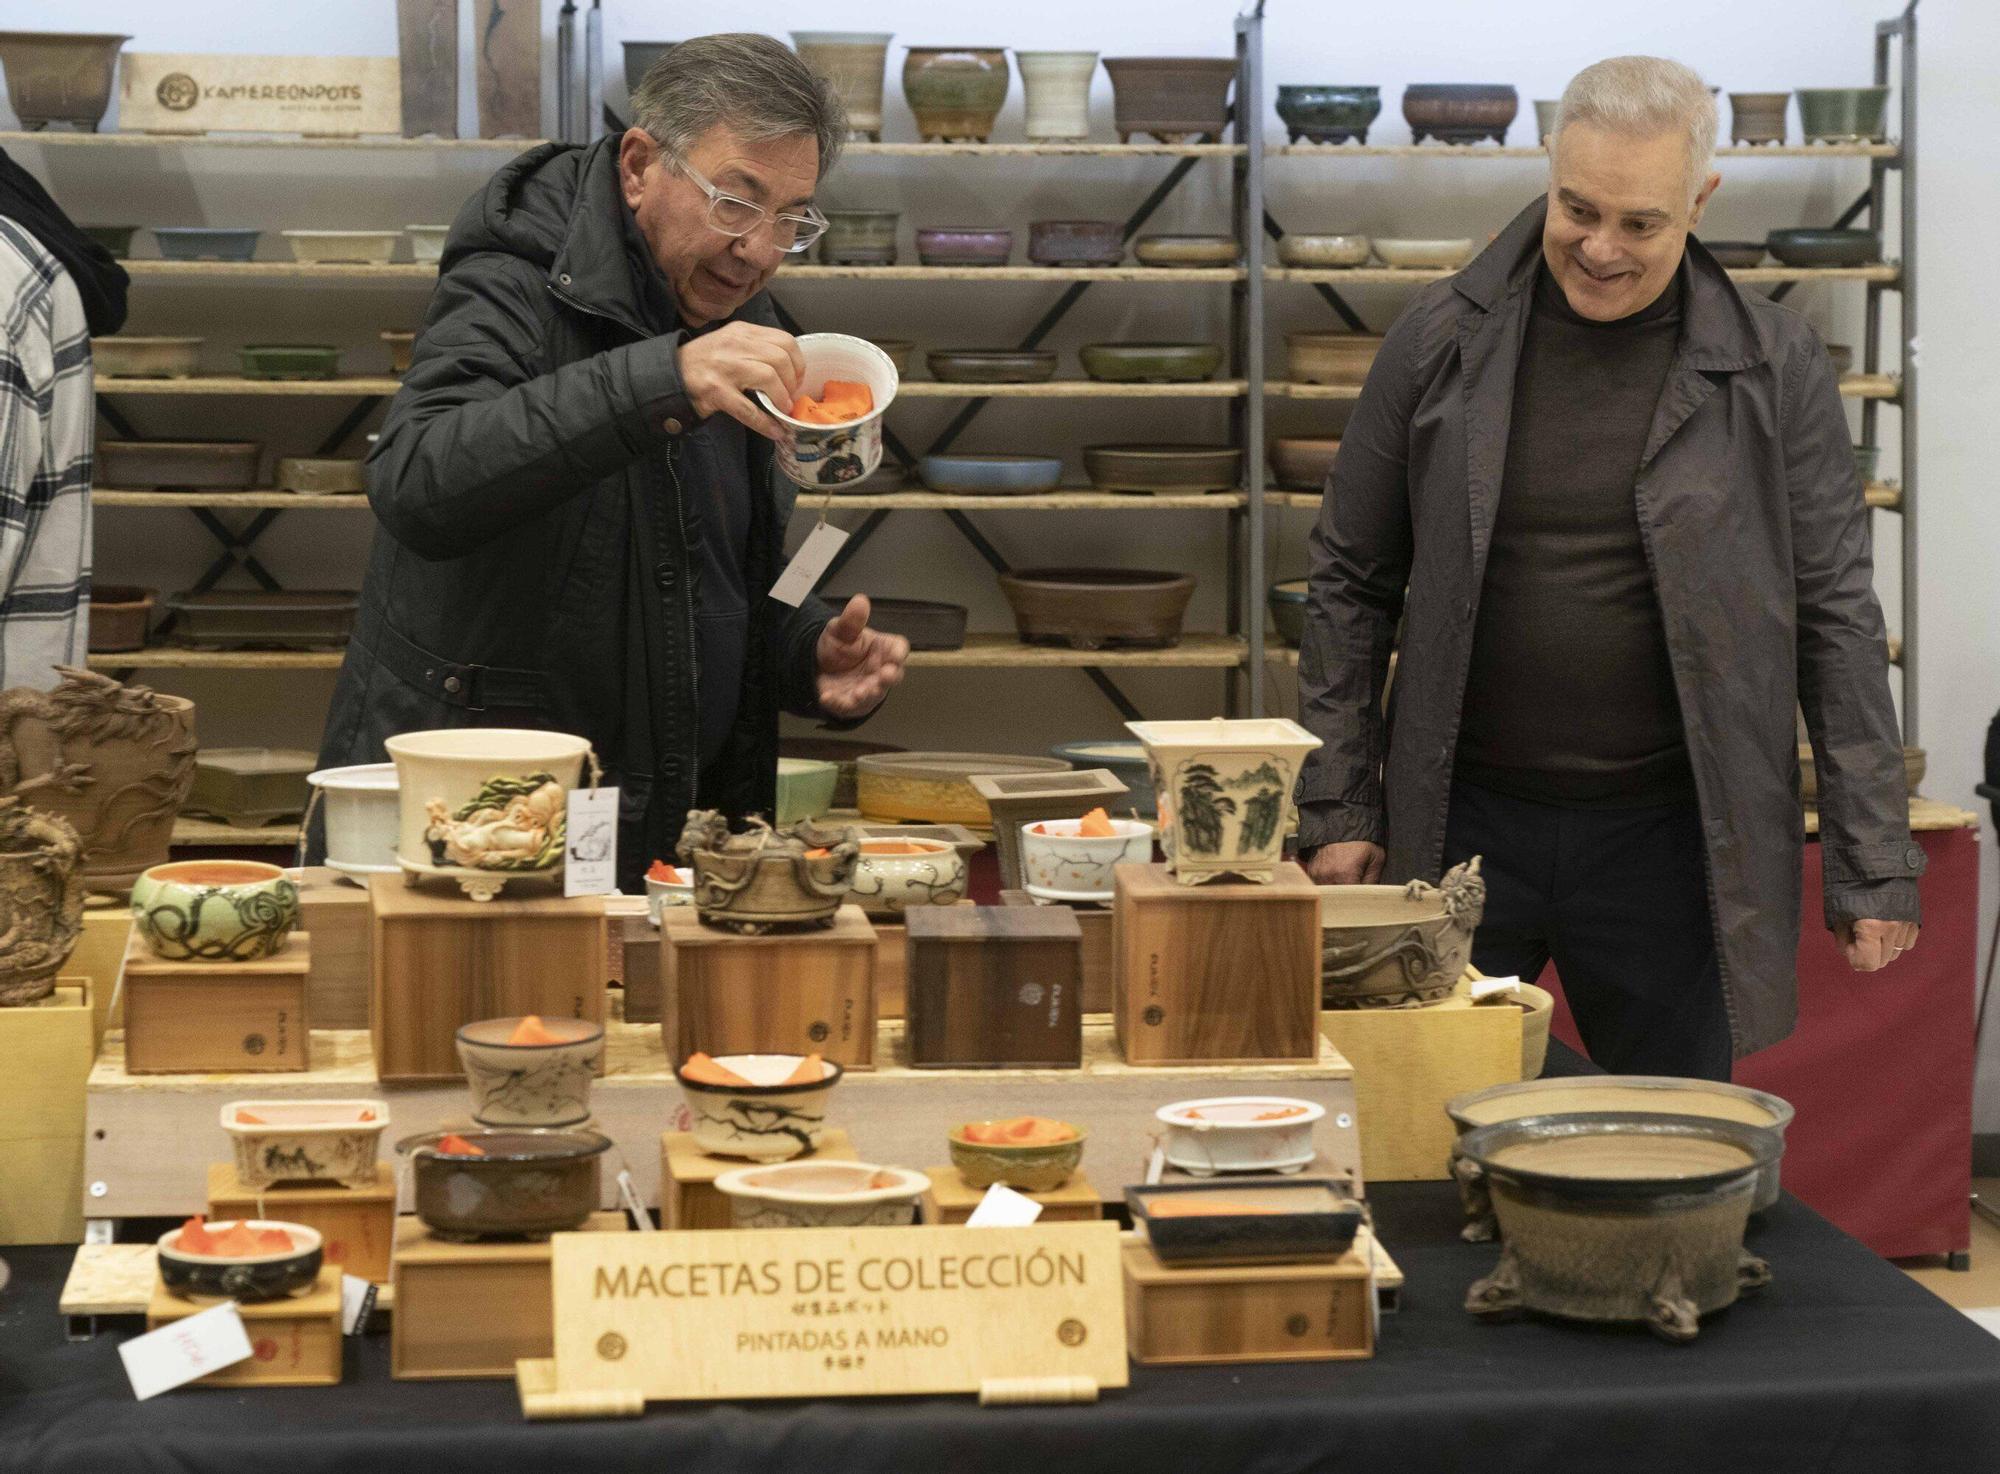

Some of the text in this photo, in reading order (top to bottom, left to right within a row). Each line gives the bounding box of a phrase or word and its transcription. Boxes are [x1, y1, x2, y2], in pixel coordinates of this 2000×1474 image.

[204, 85, 362, 101] KAMEREONPOTS
[594, 1248, 1086, 1299] MACETAS DE COLECCIÓN
[736, 1327, 949, 1353] PINTADAS A MANO
